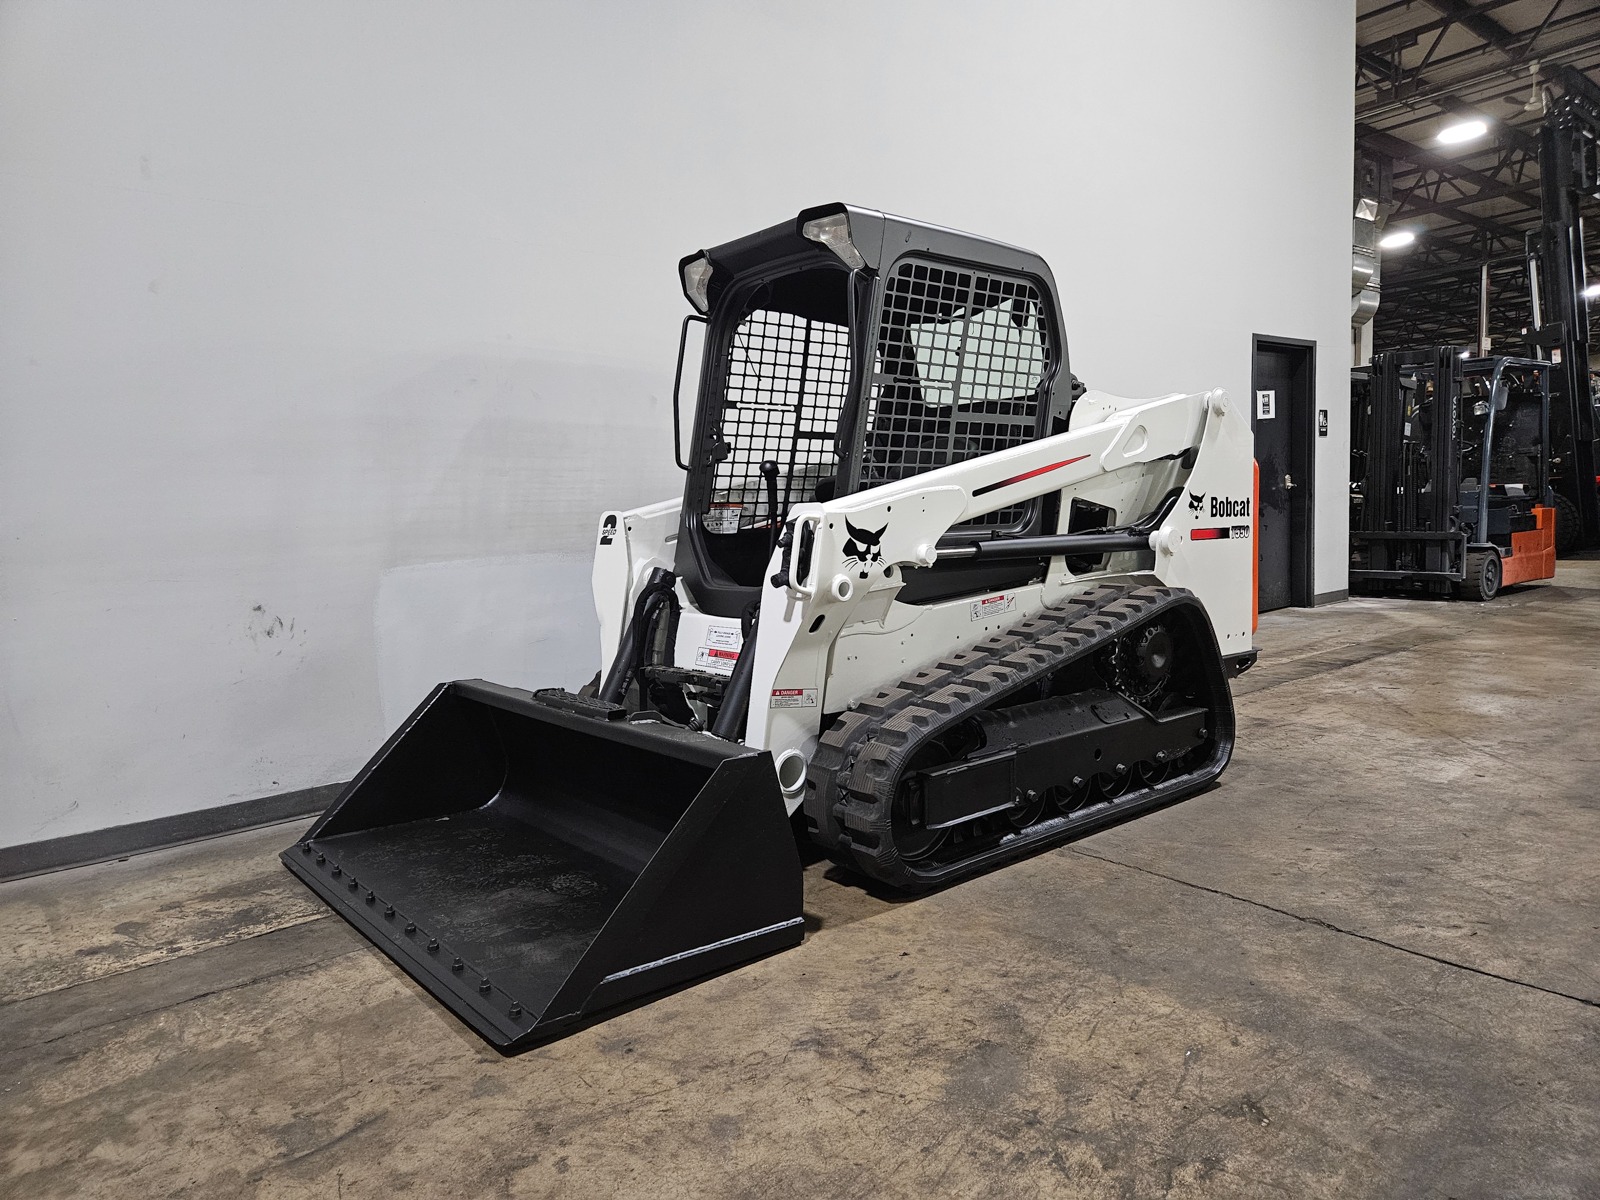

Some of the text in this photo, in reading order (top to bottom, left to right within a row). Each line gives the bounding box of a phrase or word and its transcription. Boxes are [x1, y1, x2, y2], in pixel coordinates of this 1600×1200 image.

[1211, 496, 1250, 518] Bobcat
[600, 514, 617, 545] 2
[601, 528, 617, 536] SPEED
[718, 650, 735, 659] WARNING
